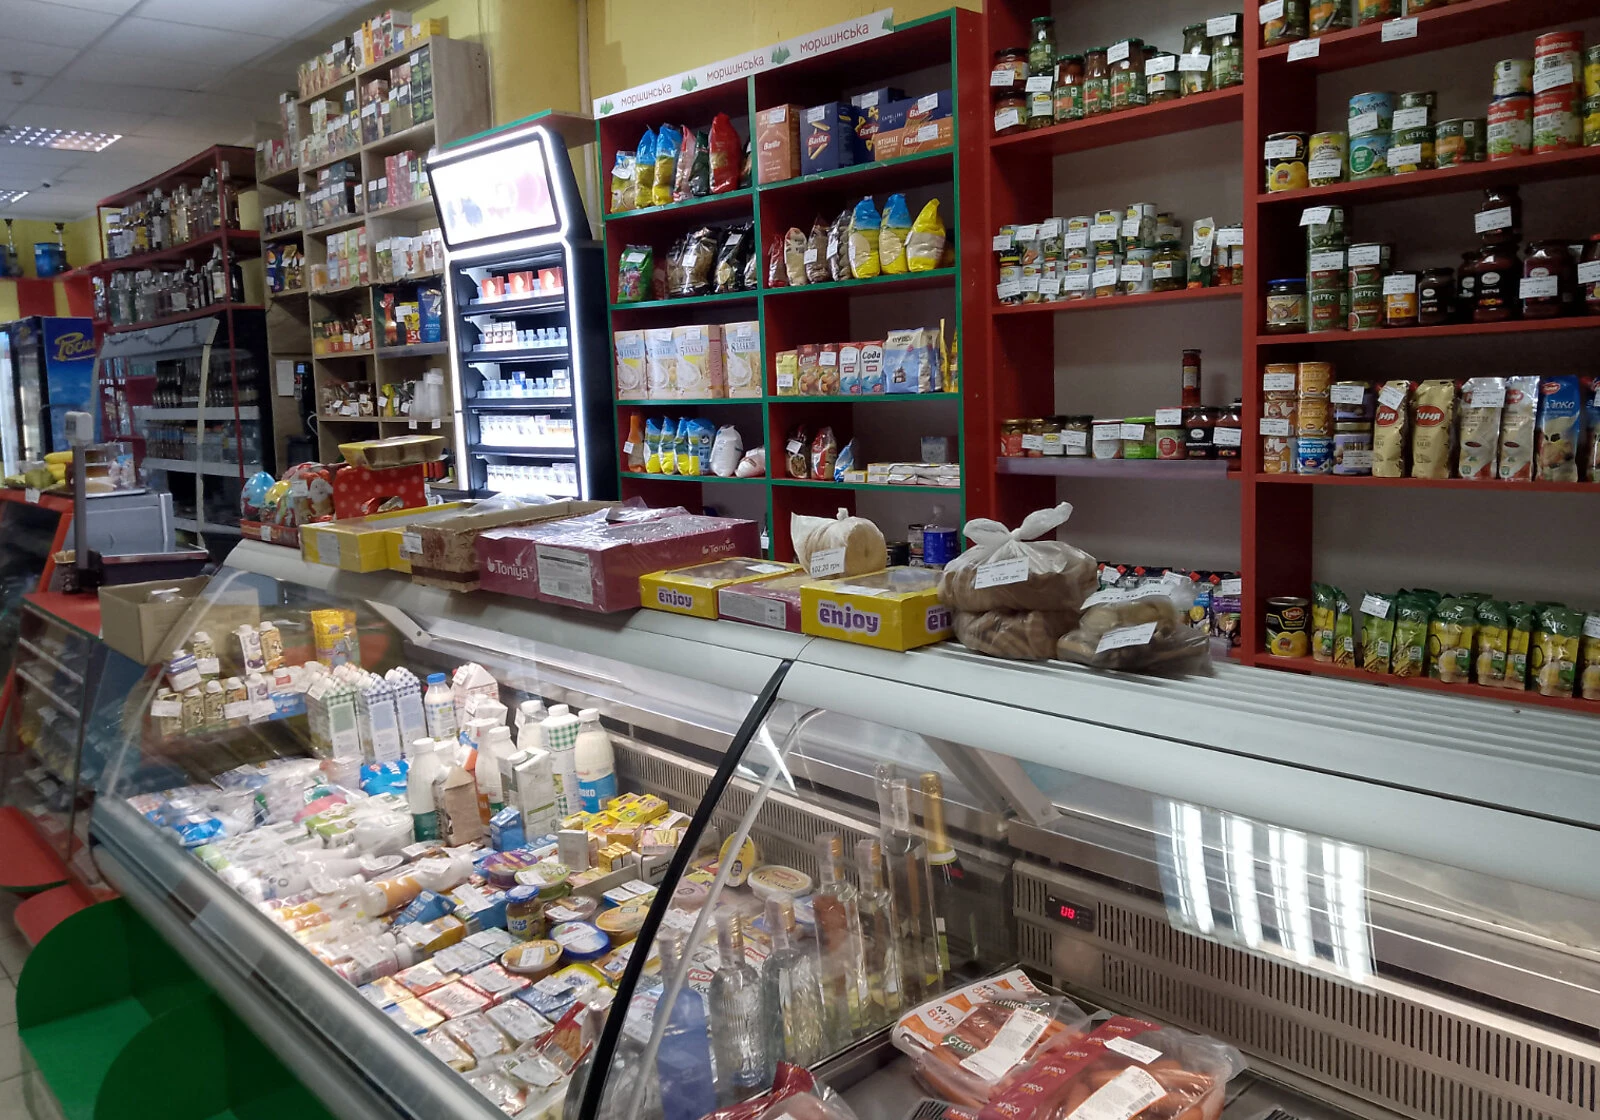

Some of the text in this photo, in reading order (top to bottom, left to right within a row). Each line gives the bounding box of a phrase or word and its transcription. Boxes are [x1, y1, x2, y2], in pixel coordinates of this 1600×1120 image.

[800, 22, 869, 54] моршинська
[706, 55, 764, 81] моршинська
[621, 84, 672, 106] моршинська
[862, 350, 881, 360] Сода
[495, 557, 529, 581] Toniya
[659, 590, 693, 608] enjoy
[819, 606, 879, 633] enjoy
